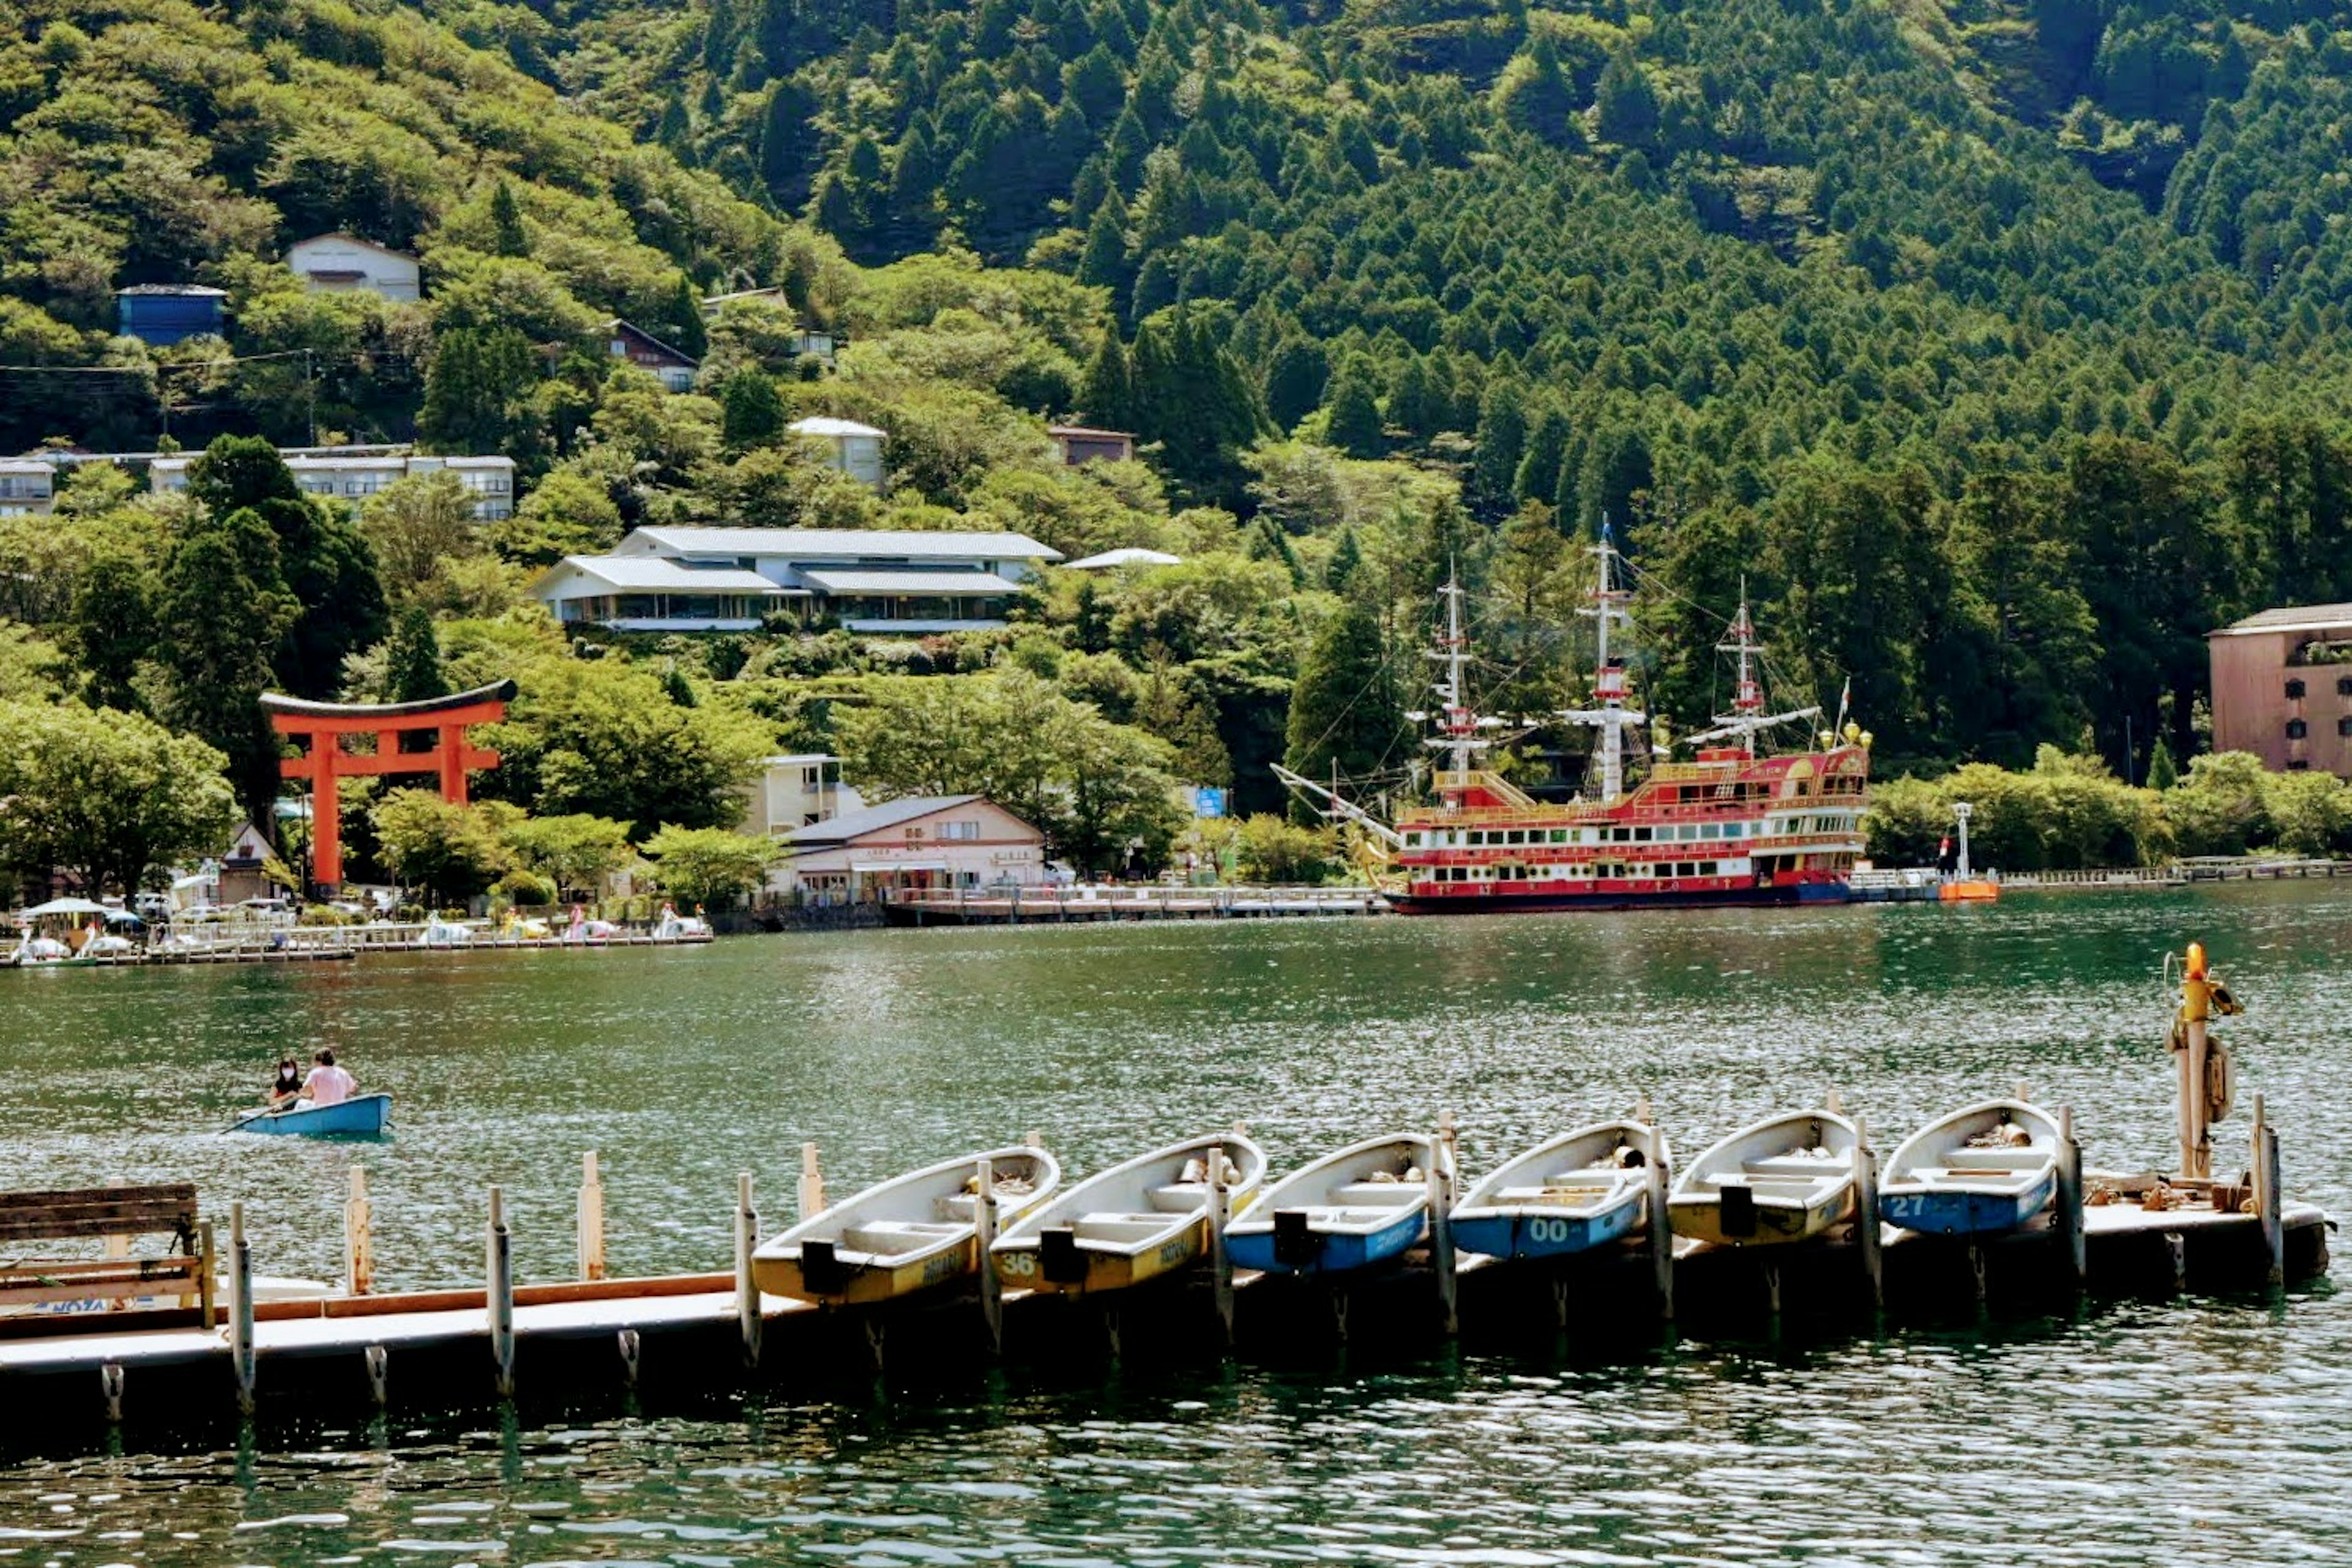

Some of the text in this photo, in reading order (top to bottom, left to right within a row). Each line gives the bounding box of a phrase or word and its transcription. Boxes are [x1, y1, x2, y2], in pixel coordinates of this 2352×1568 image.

[1891, 1196, 1924, 1217] 27
[1531, 1218, 1568, 1242] 00
[1001, 1253, 1035, 1275] 36
